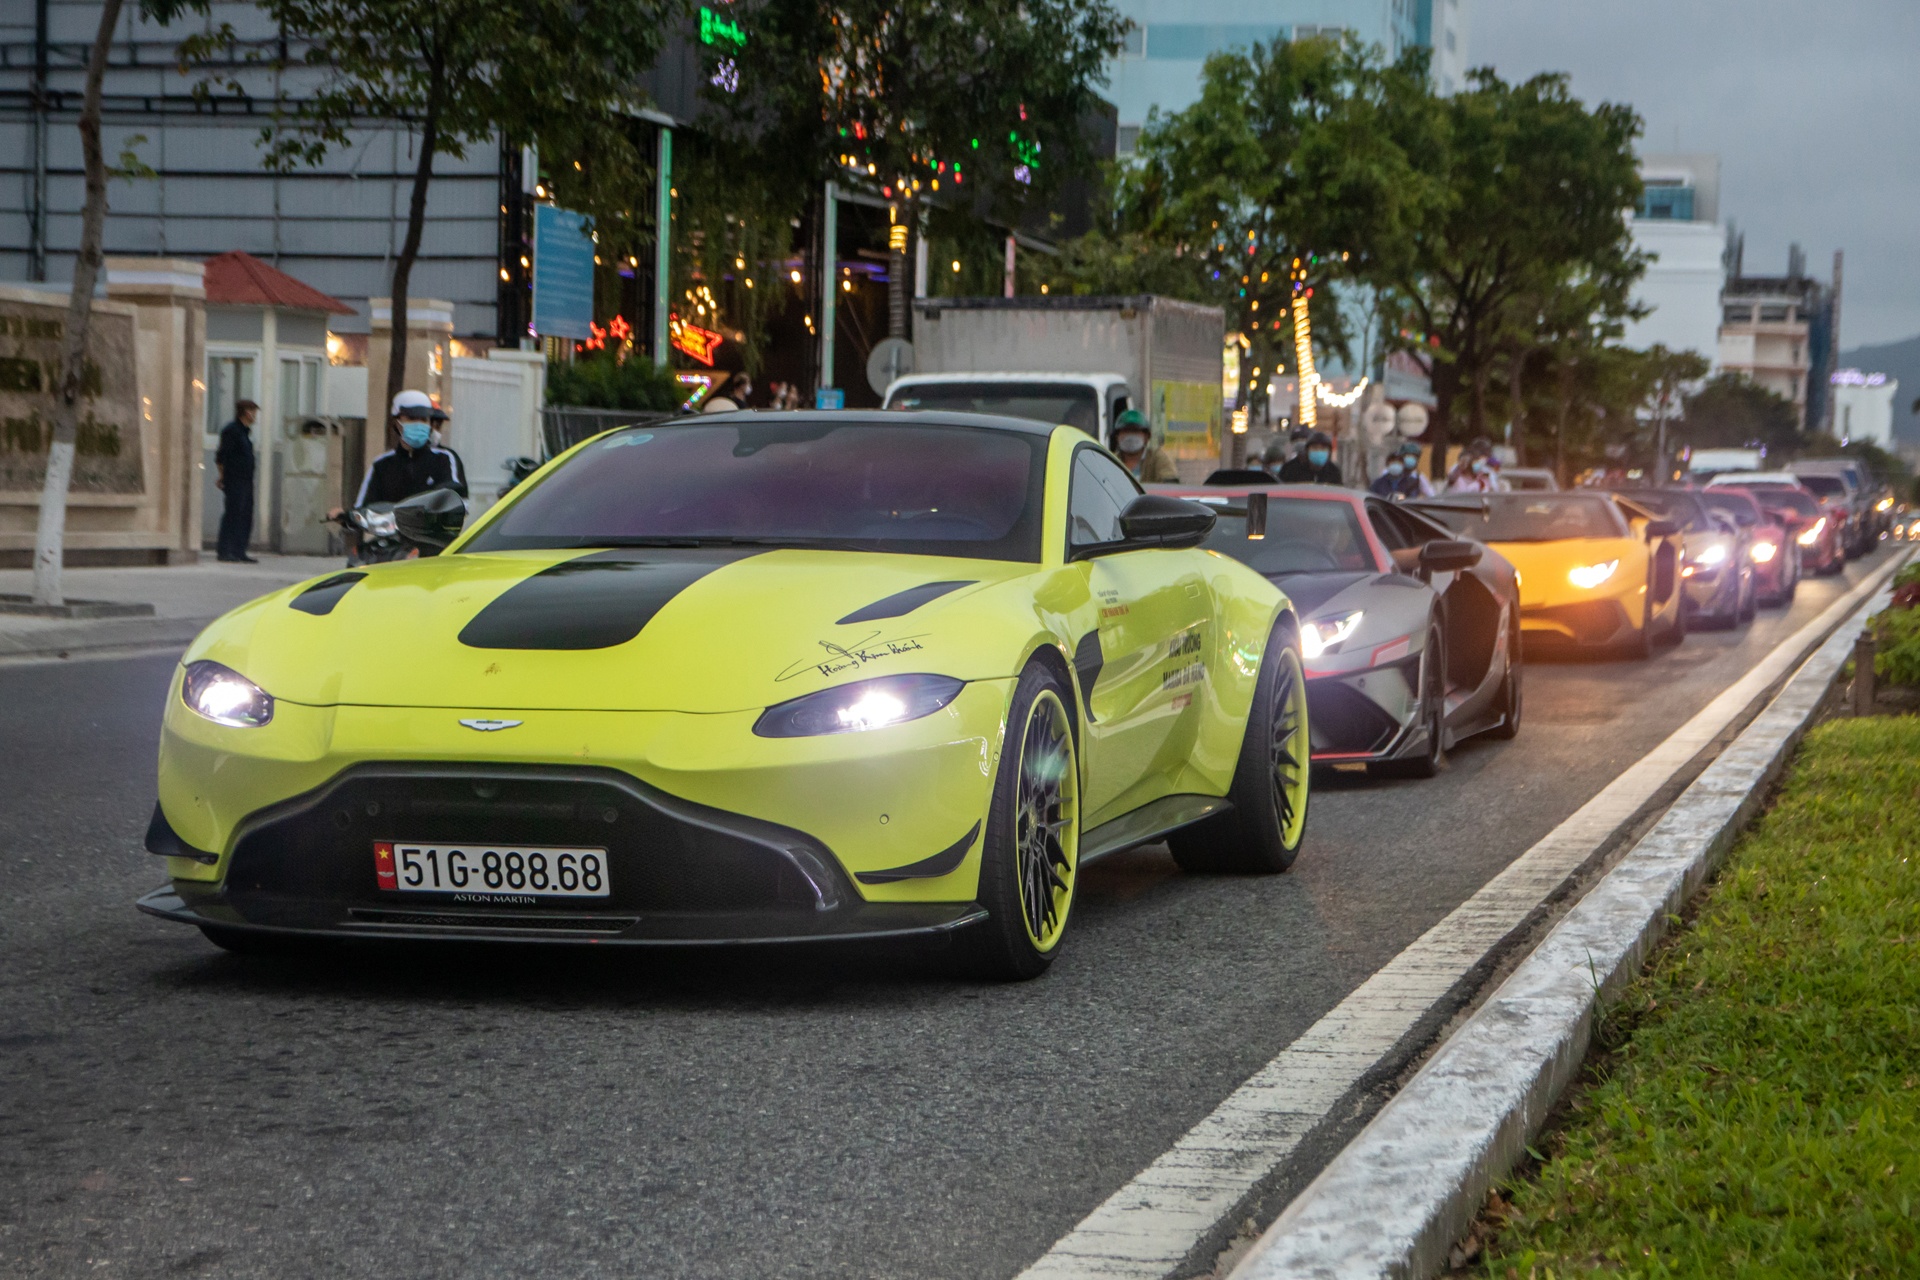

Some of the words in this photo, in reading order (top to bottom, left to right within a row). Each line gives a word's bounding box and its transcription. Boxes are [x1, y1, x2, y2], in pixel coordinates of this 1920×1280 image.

[401, 848, 602, 892] 51G-888.68
[453, 893, 491, 903] ASTON
[493, 895, 536, 904] MARTIN
